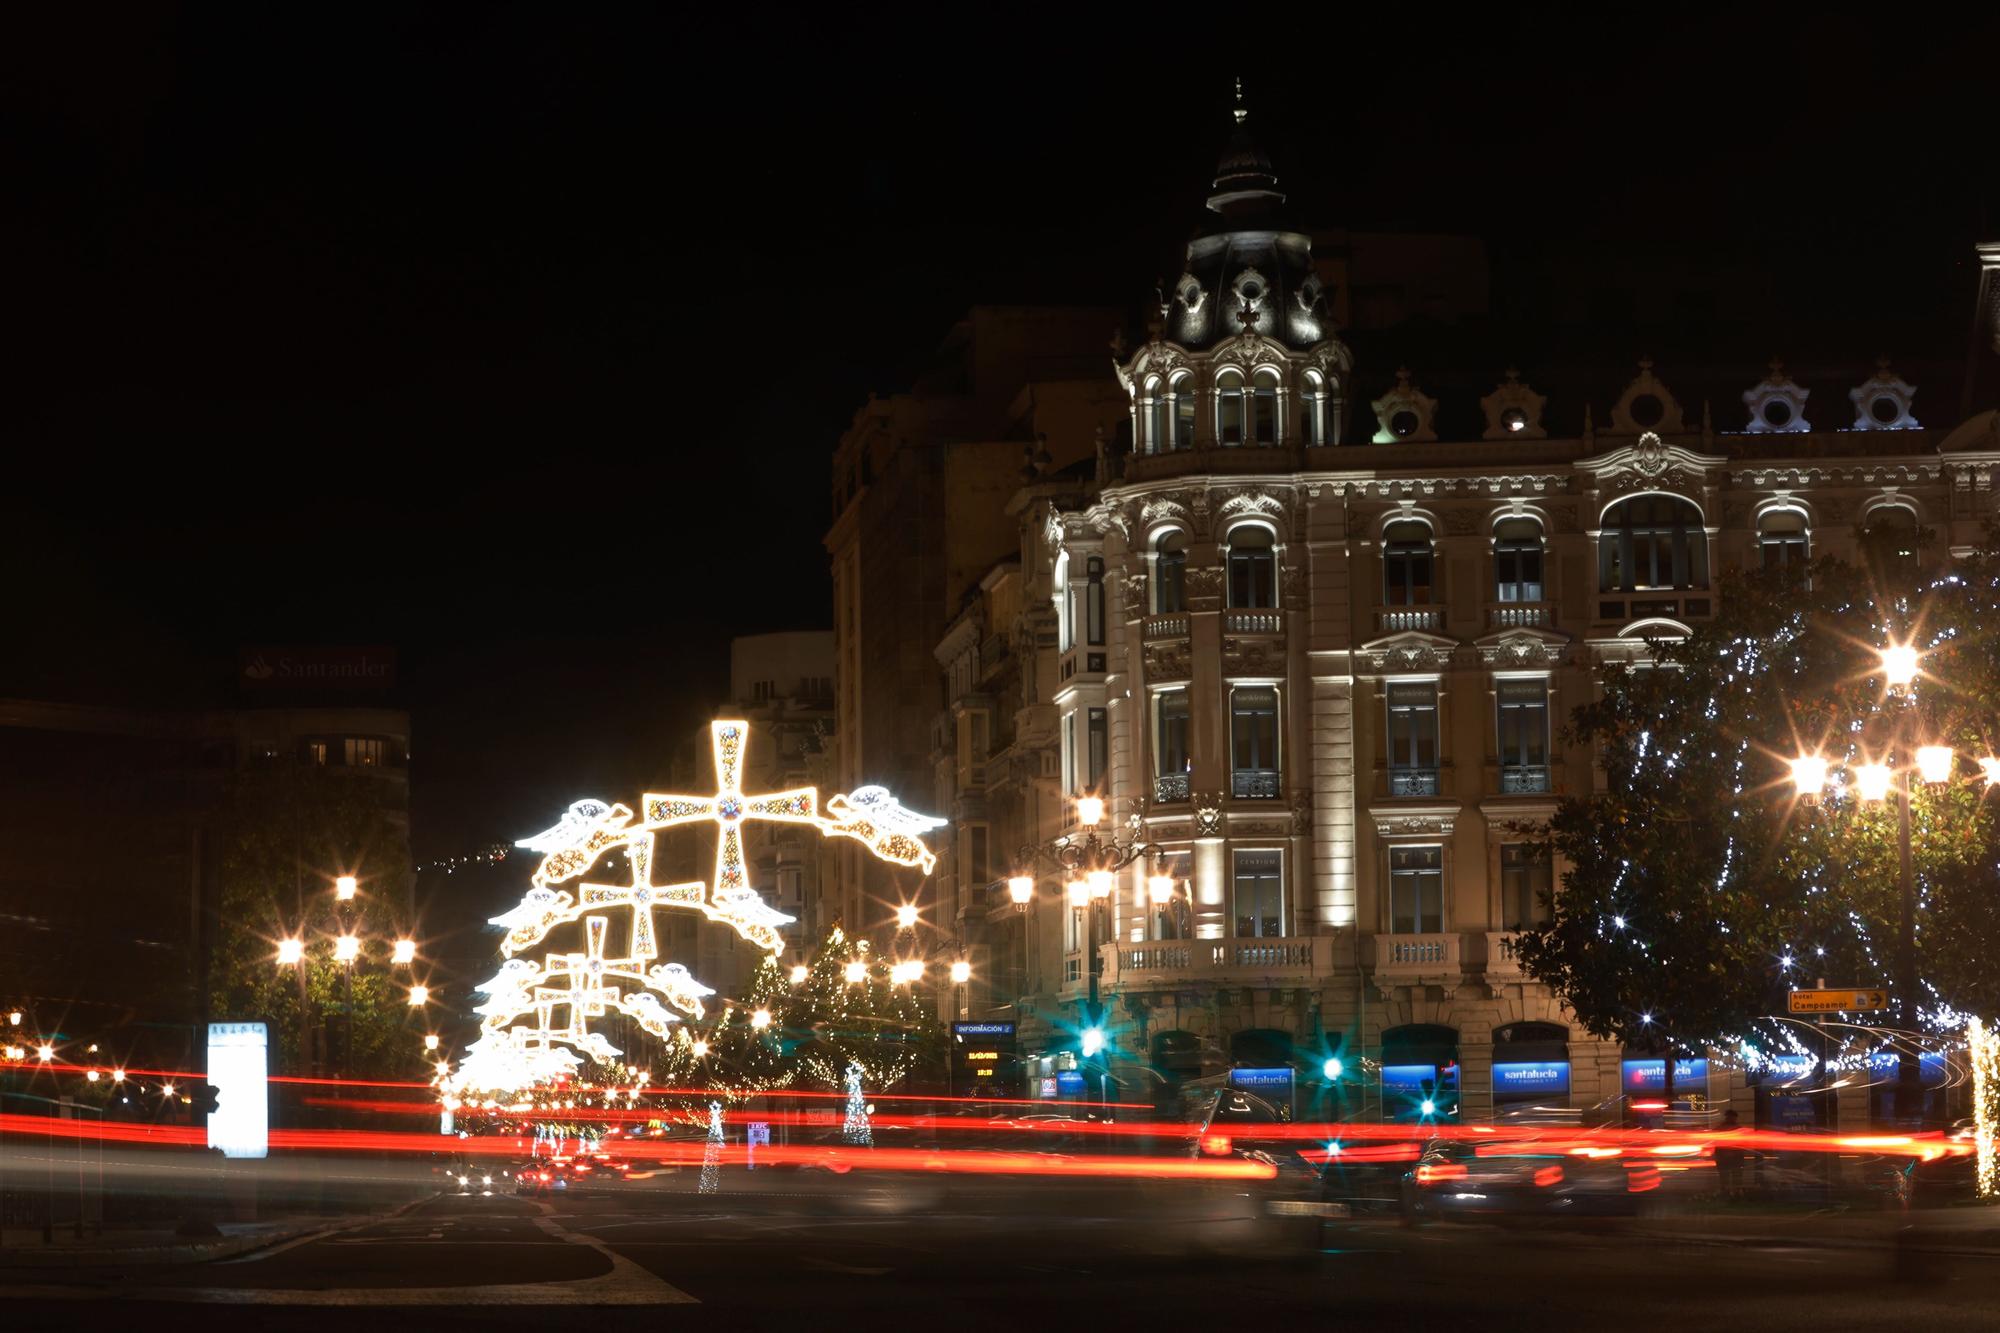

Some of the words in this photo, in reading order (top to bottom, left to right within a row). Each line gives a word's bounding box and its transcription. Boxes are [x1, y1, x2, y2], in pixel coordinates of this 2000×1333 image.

[279, 655, 390, 678] Santander
[1794, 1002, 1848, 1010] Campoamor
[1236, 1075, 1288, 1084] santalucía
